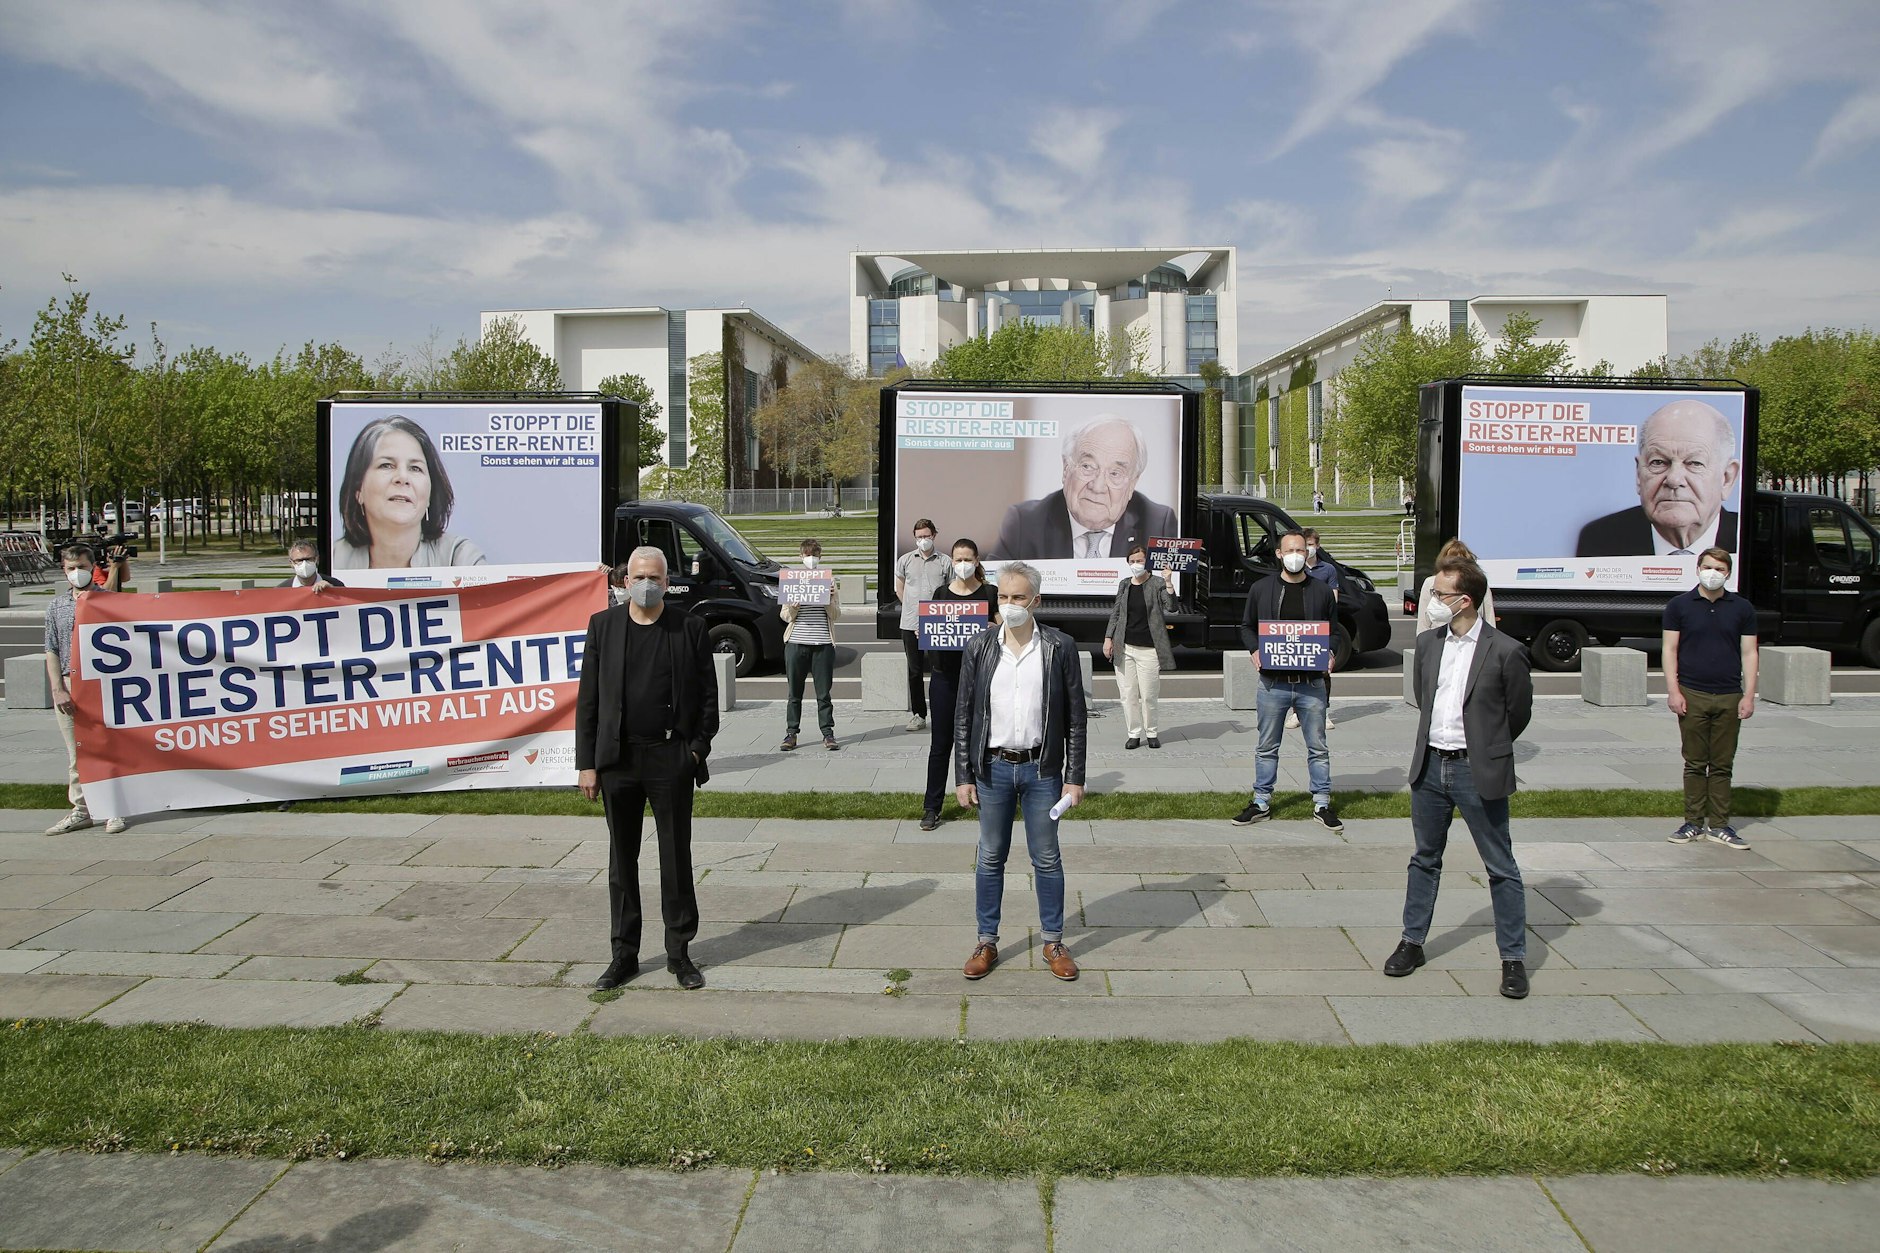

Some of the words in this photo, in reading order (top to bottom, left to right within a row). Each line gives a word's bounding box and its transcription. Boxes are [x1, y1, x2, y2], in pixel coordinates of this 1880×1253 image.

[905, 401, 976, 417] STOPPT
[980, 402, 1010, 418] DIE
[1469, 401, 1548, 420] STOPPT
[1552, 404, 1585, 421] DIE
[490, 415, 562, 431] STOPPT
[566, 415, 595, 431] DIE
[905, 419, 1056, 436] RIESTER-RENTE!
[1468, 422, 1636, 443] RIESTER-RENTE!
[442, 435, 594, 451] RIESTER-RENTE!
[904, 438, 932, 447] Sonst
[933, 439, 962, 448] sehen
[963, 440, 978, 448] wir
[980, 440, 993, 448] alt
[994, 441, 1011, 449] aus
[1468, 442, 1495, 452] Sonst
[1496, 443, 1525, 453] sehen
[1526, 444, 1541, 453] wir
[1543, 445, 1556, 454] alt
[1556, 446, 1574, 454] aus
[482, 456, 511, 466] Sonst
[513, 456, 543, 466] sehen
[544, 456, 560, 466] wir
[562, 456, 575, 466] alt
[576, 457, 595, 466] aus
[1156, 539, 1196, 549] STOPPT
[1150, 551, 1198, 563] RIESTER-
[1153, 560, 1188, 571] RENTE
[787, 570, 825, 580] STOPPT
[783, 584, 829, 594] RIESTER-
[786, 593, 821, 603] RENTE
[928, 603, 979, 615] STOPPT
[945, 614, 960, 622] DIE
[924, 622, 986, 635] RIESTER-
[1269, 623, 1320, 635] STOPPT
[91, 610, 340, 674] STOPPT
[358, 599, 452, 653] DIE
[1286, 634, 1300, 642] DIE
[1264, 642, 1328, 655] RIESTER-
[1270, 654, 1316, 667] RENTE
[154, 717, 261, 752] SONST
[268, 706, 369, 739] SEHEN
[375, 700, 432, 728] WIR
[439, 693, 491, 722] ALT
[499, 688, 556, 716] AUS
[448, 752, 508, 766] verbraucherzentrale
[369, 762, 410, 771] Bürgerbewegung
[368, 767, 426, 780] FINANZWENDE
